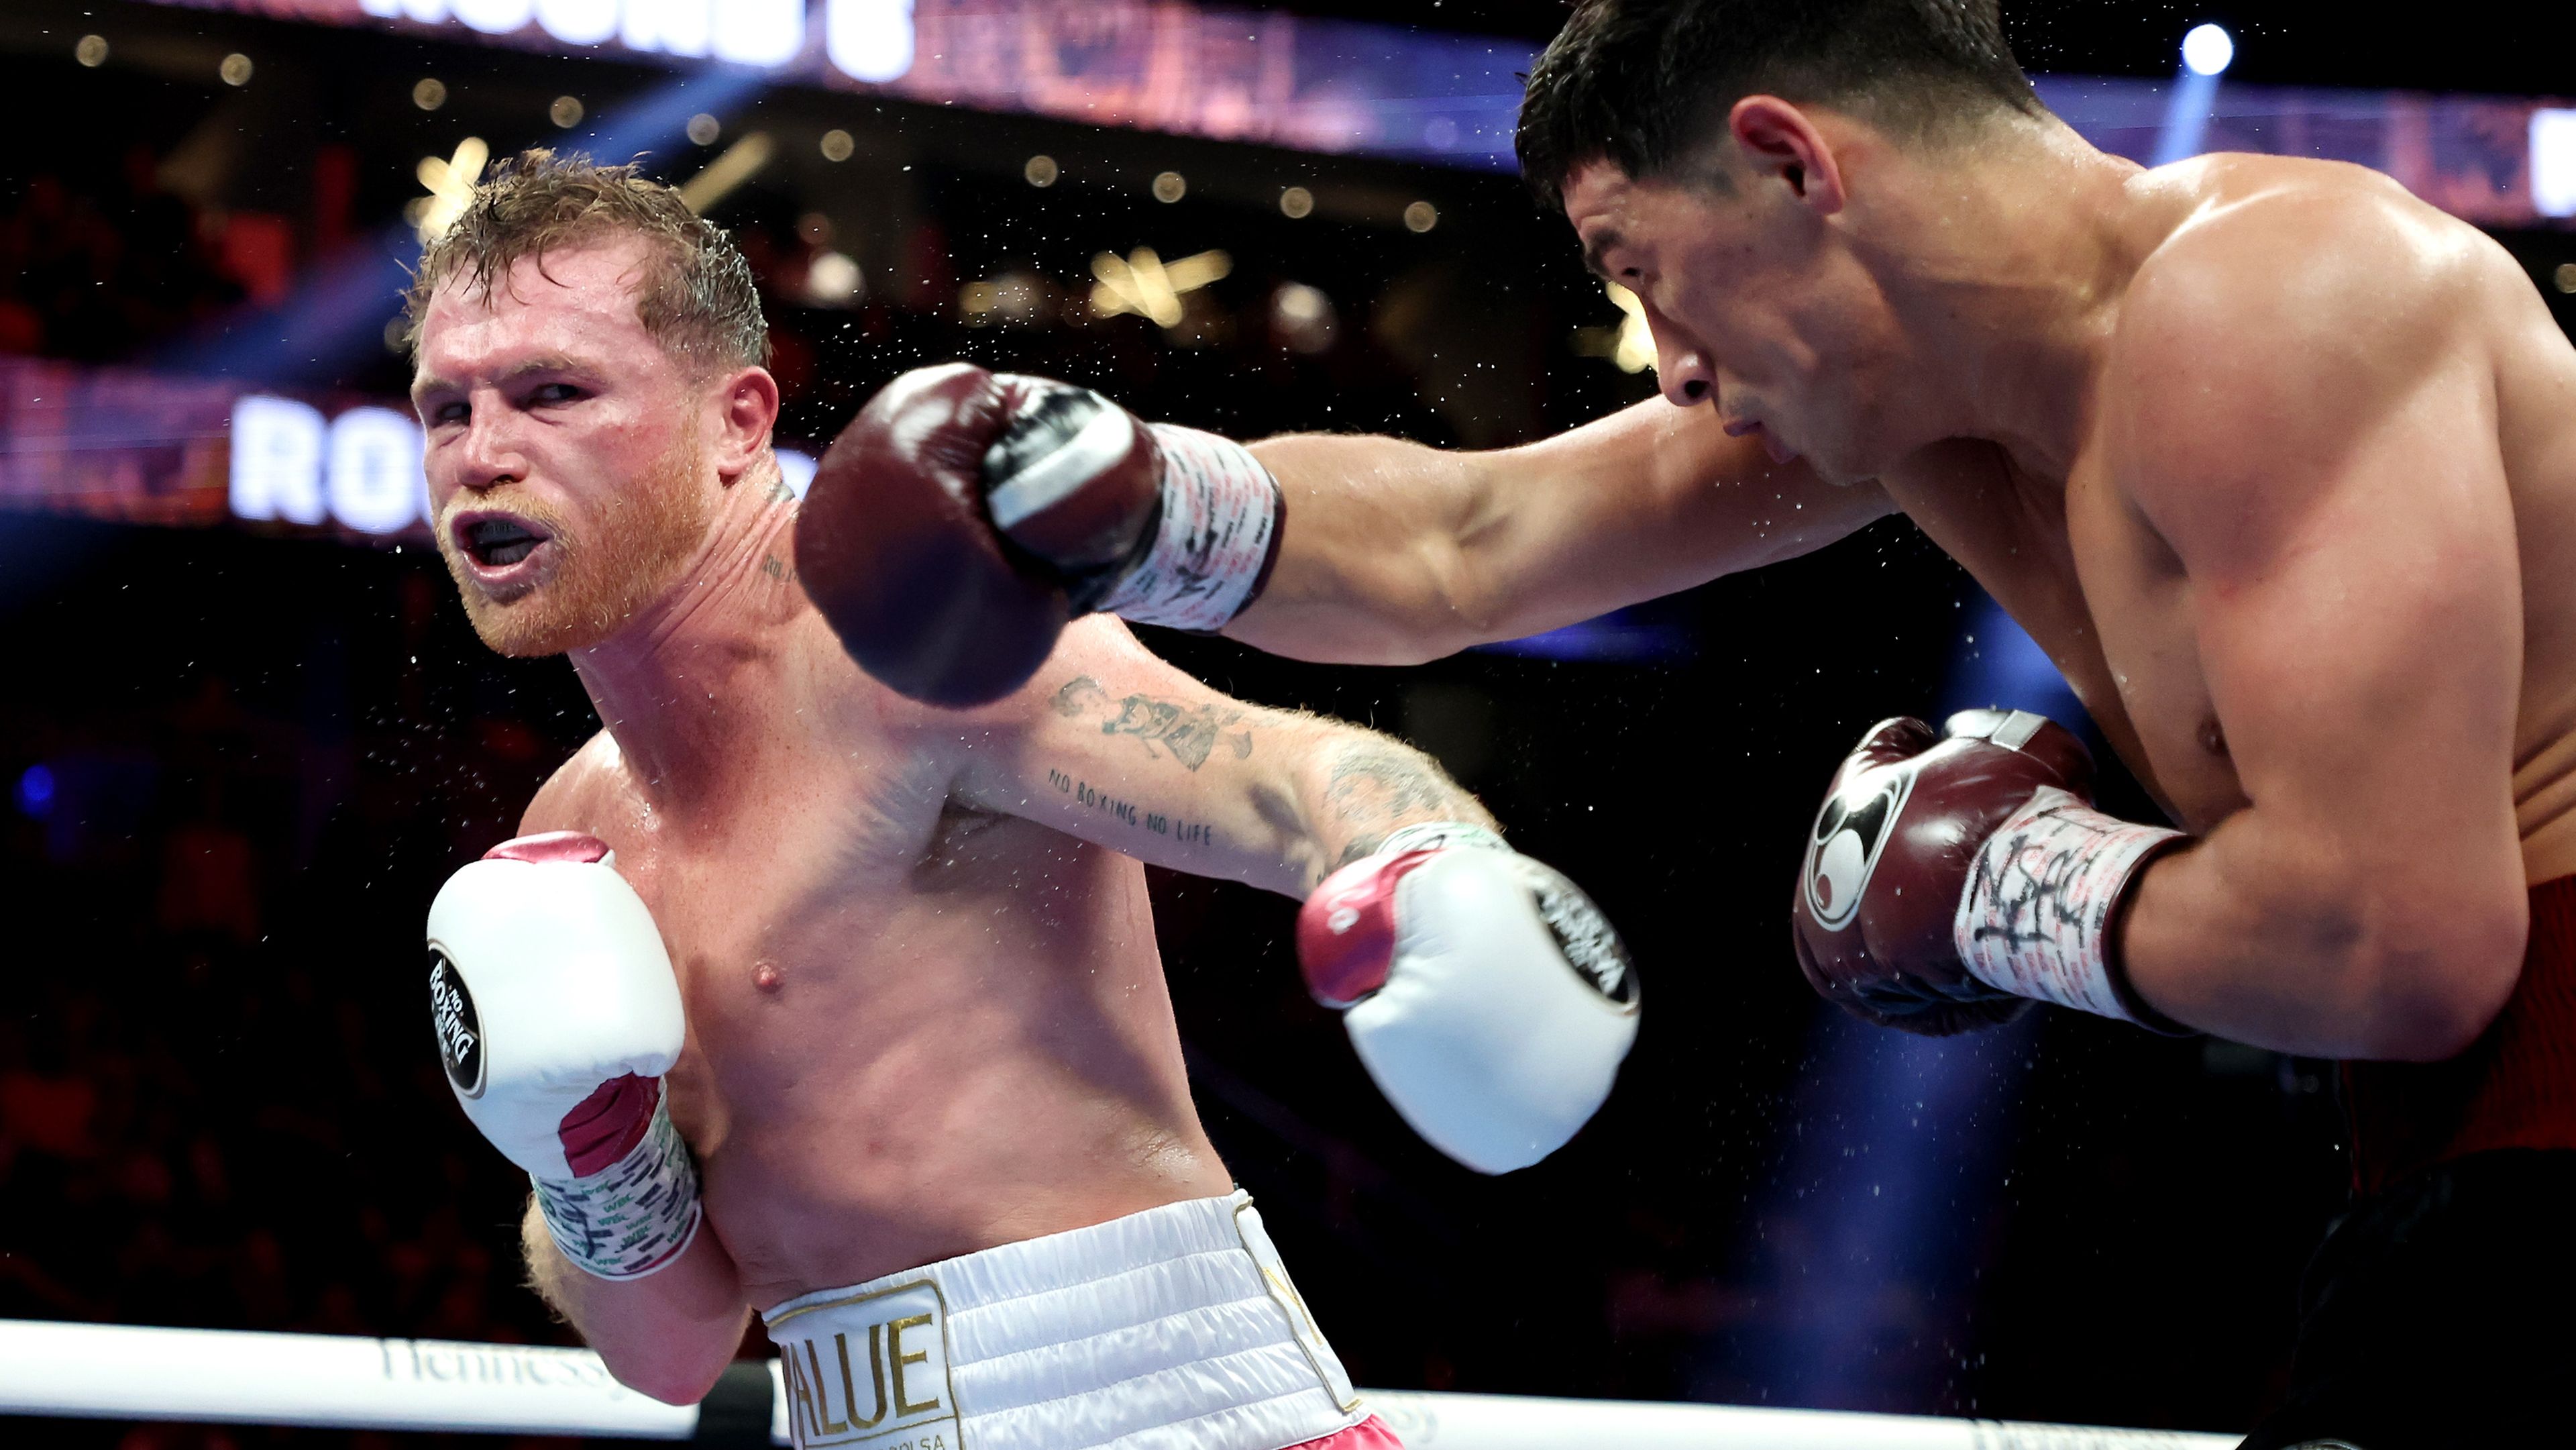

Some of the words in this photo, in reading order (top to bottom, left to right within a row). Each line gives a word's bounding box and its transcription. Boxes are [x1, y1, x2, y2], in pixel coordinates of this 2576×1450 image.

[1049, 769, 1070, 793] NO
[1077, 782, 1136, 826] BOXING
[1146, 813, 1167, 835] NO
[1177, 821, 1211, 846] LIFE
[429, 958, 474, 1064] BOXING
[448, 988, 463, 1013] NO
[379, 1337, 628, 1401] Henness
[781, 1312, 940, 1437] ALUE
